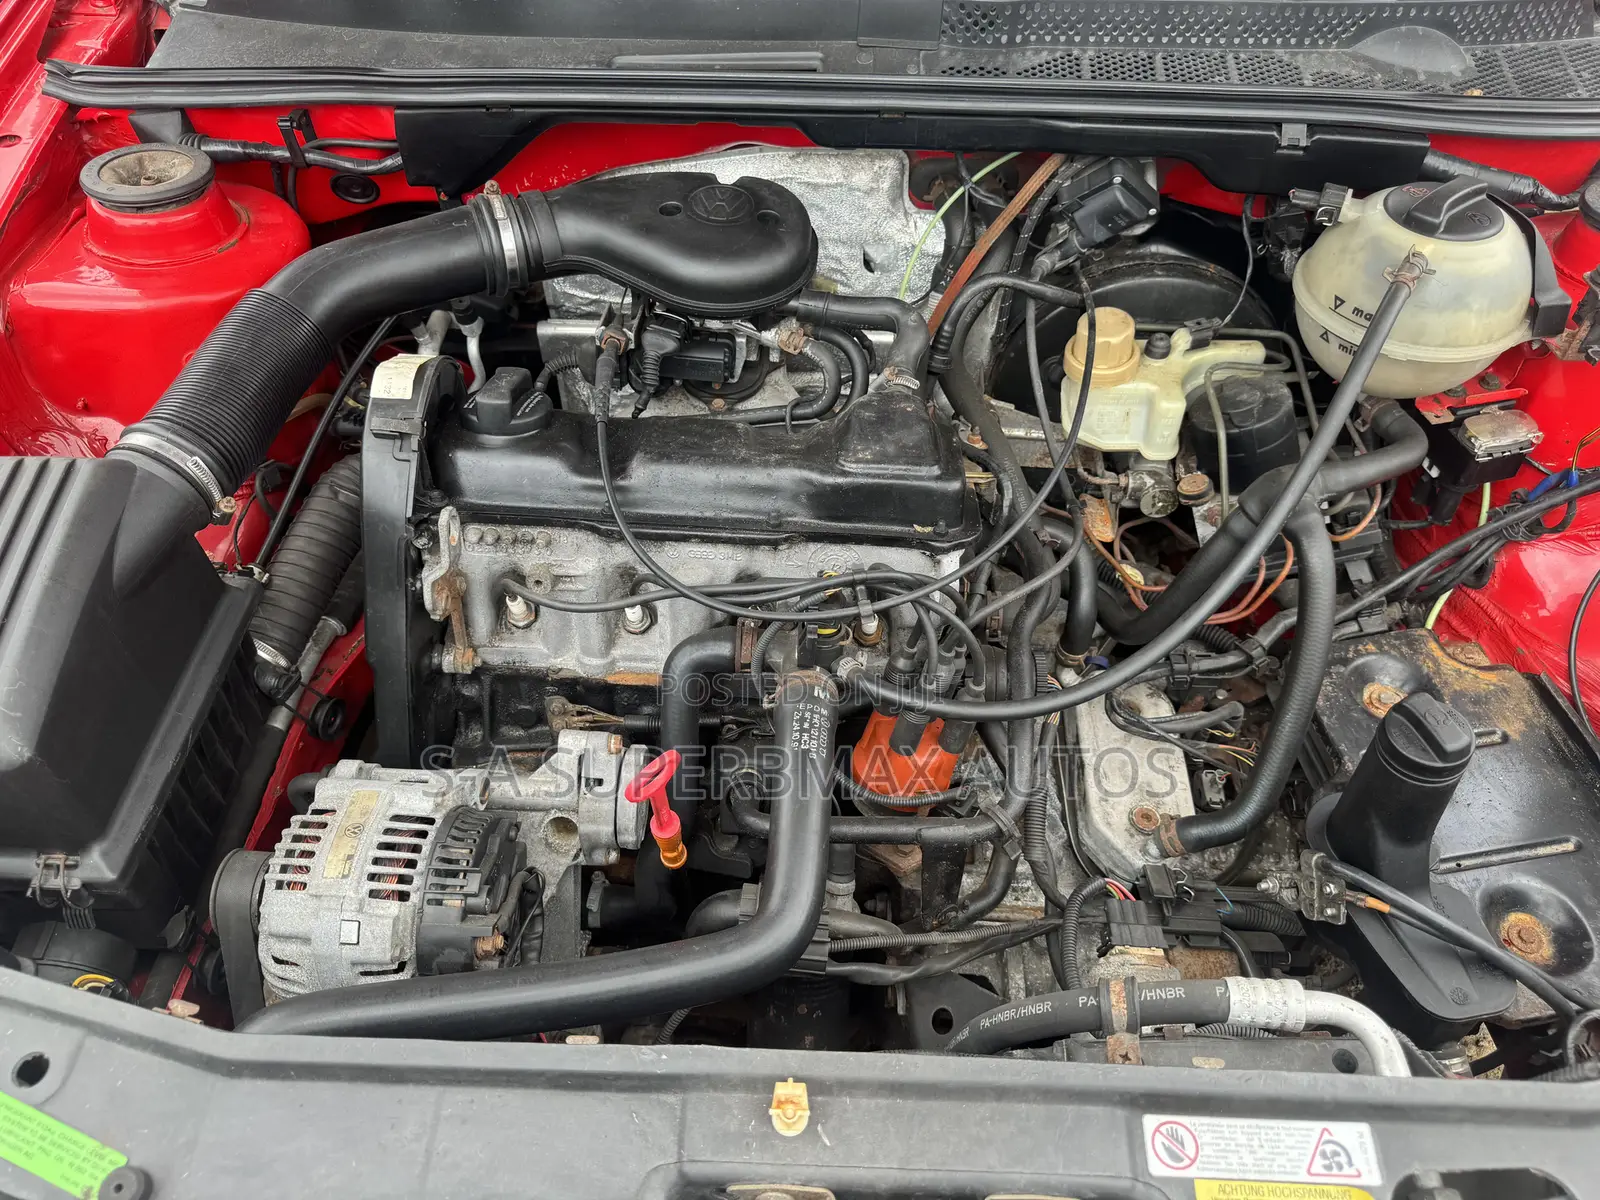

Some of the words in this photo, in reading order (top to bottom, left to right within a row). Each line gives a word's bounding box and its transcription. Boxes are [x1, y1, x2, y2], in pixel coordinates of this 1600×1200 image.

[1351, 306, 1374, 322] ma
[980, 1001, 1053, 1030] PA-HNBR/HNBR
[1217, 1183, 1265, 1197] ACHTUNG
[1267, 1185, 1351, 1200] HOCHSPANNUNG
